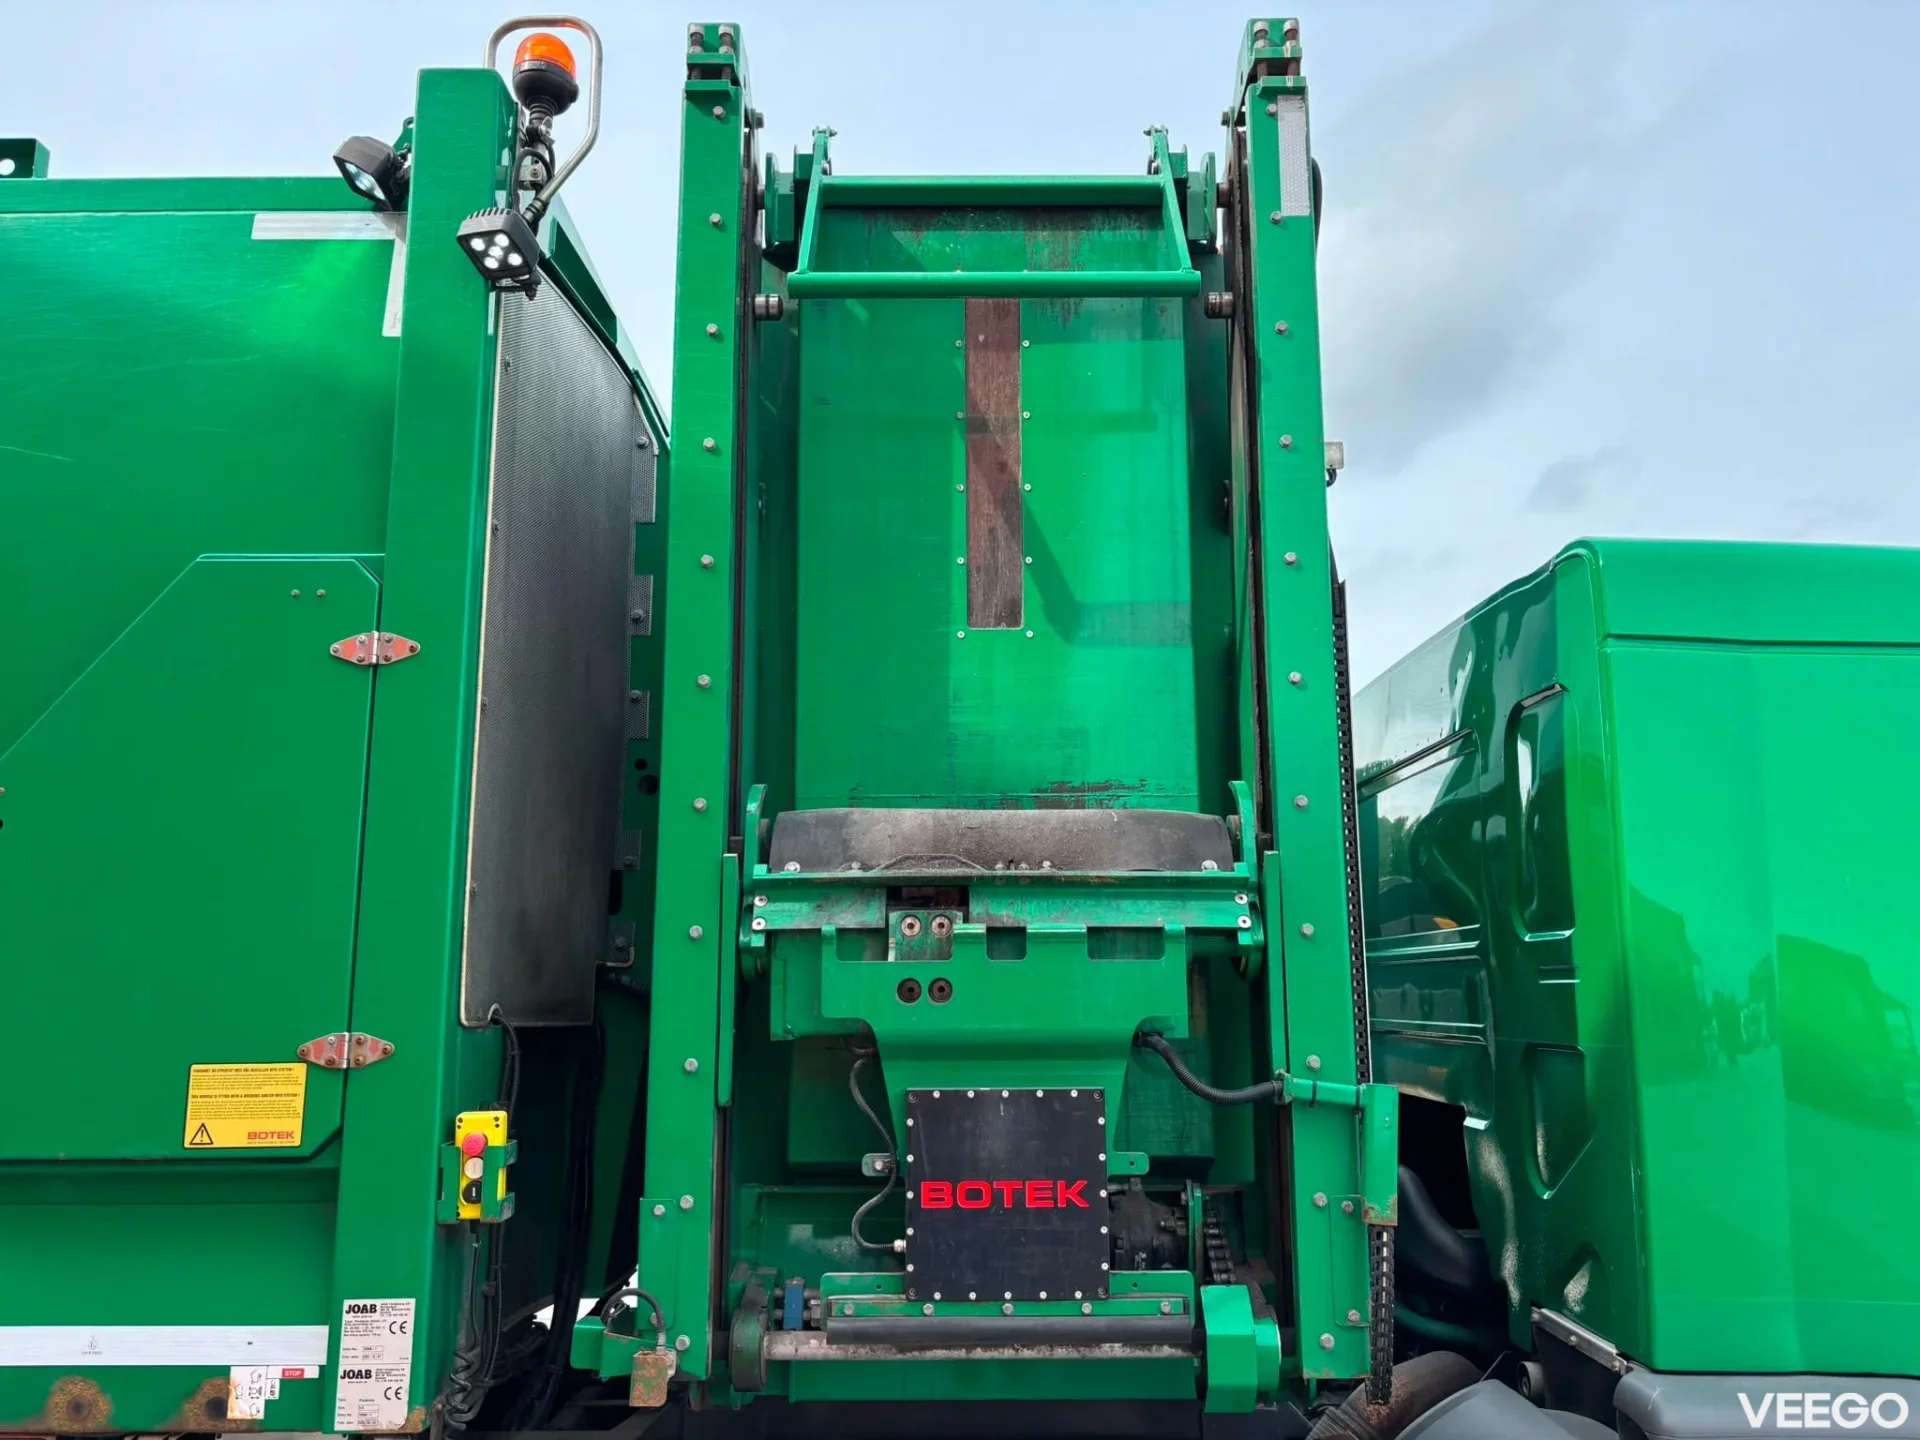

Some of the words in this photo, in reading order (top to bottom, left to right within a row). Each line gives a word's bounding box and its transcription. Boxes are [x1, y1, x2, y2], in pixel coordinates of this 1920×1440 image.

[247, 1131, 295, 1140] BOTEK
[920, 1180, 1090, 1209] BOTEK
[345, 1304, 378, 1314] JOAB
[340, 1369, 372, 1380] JOAB
